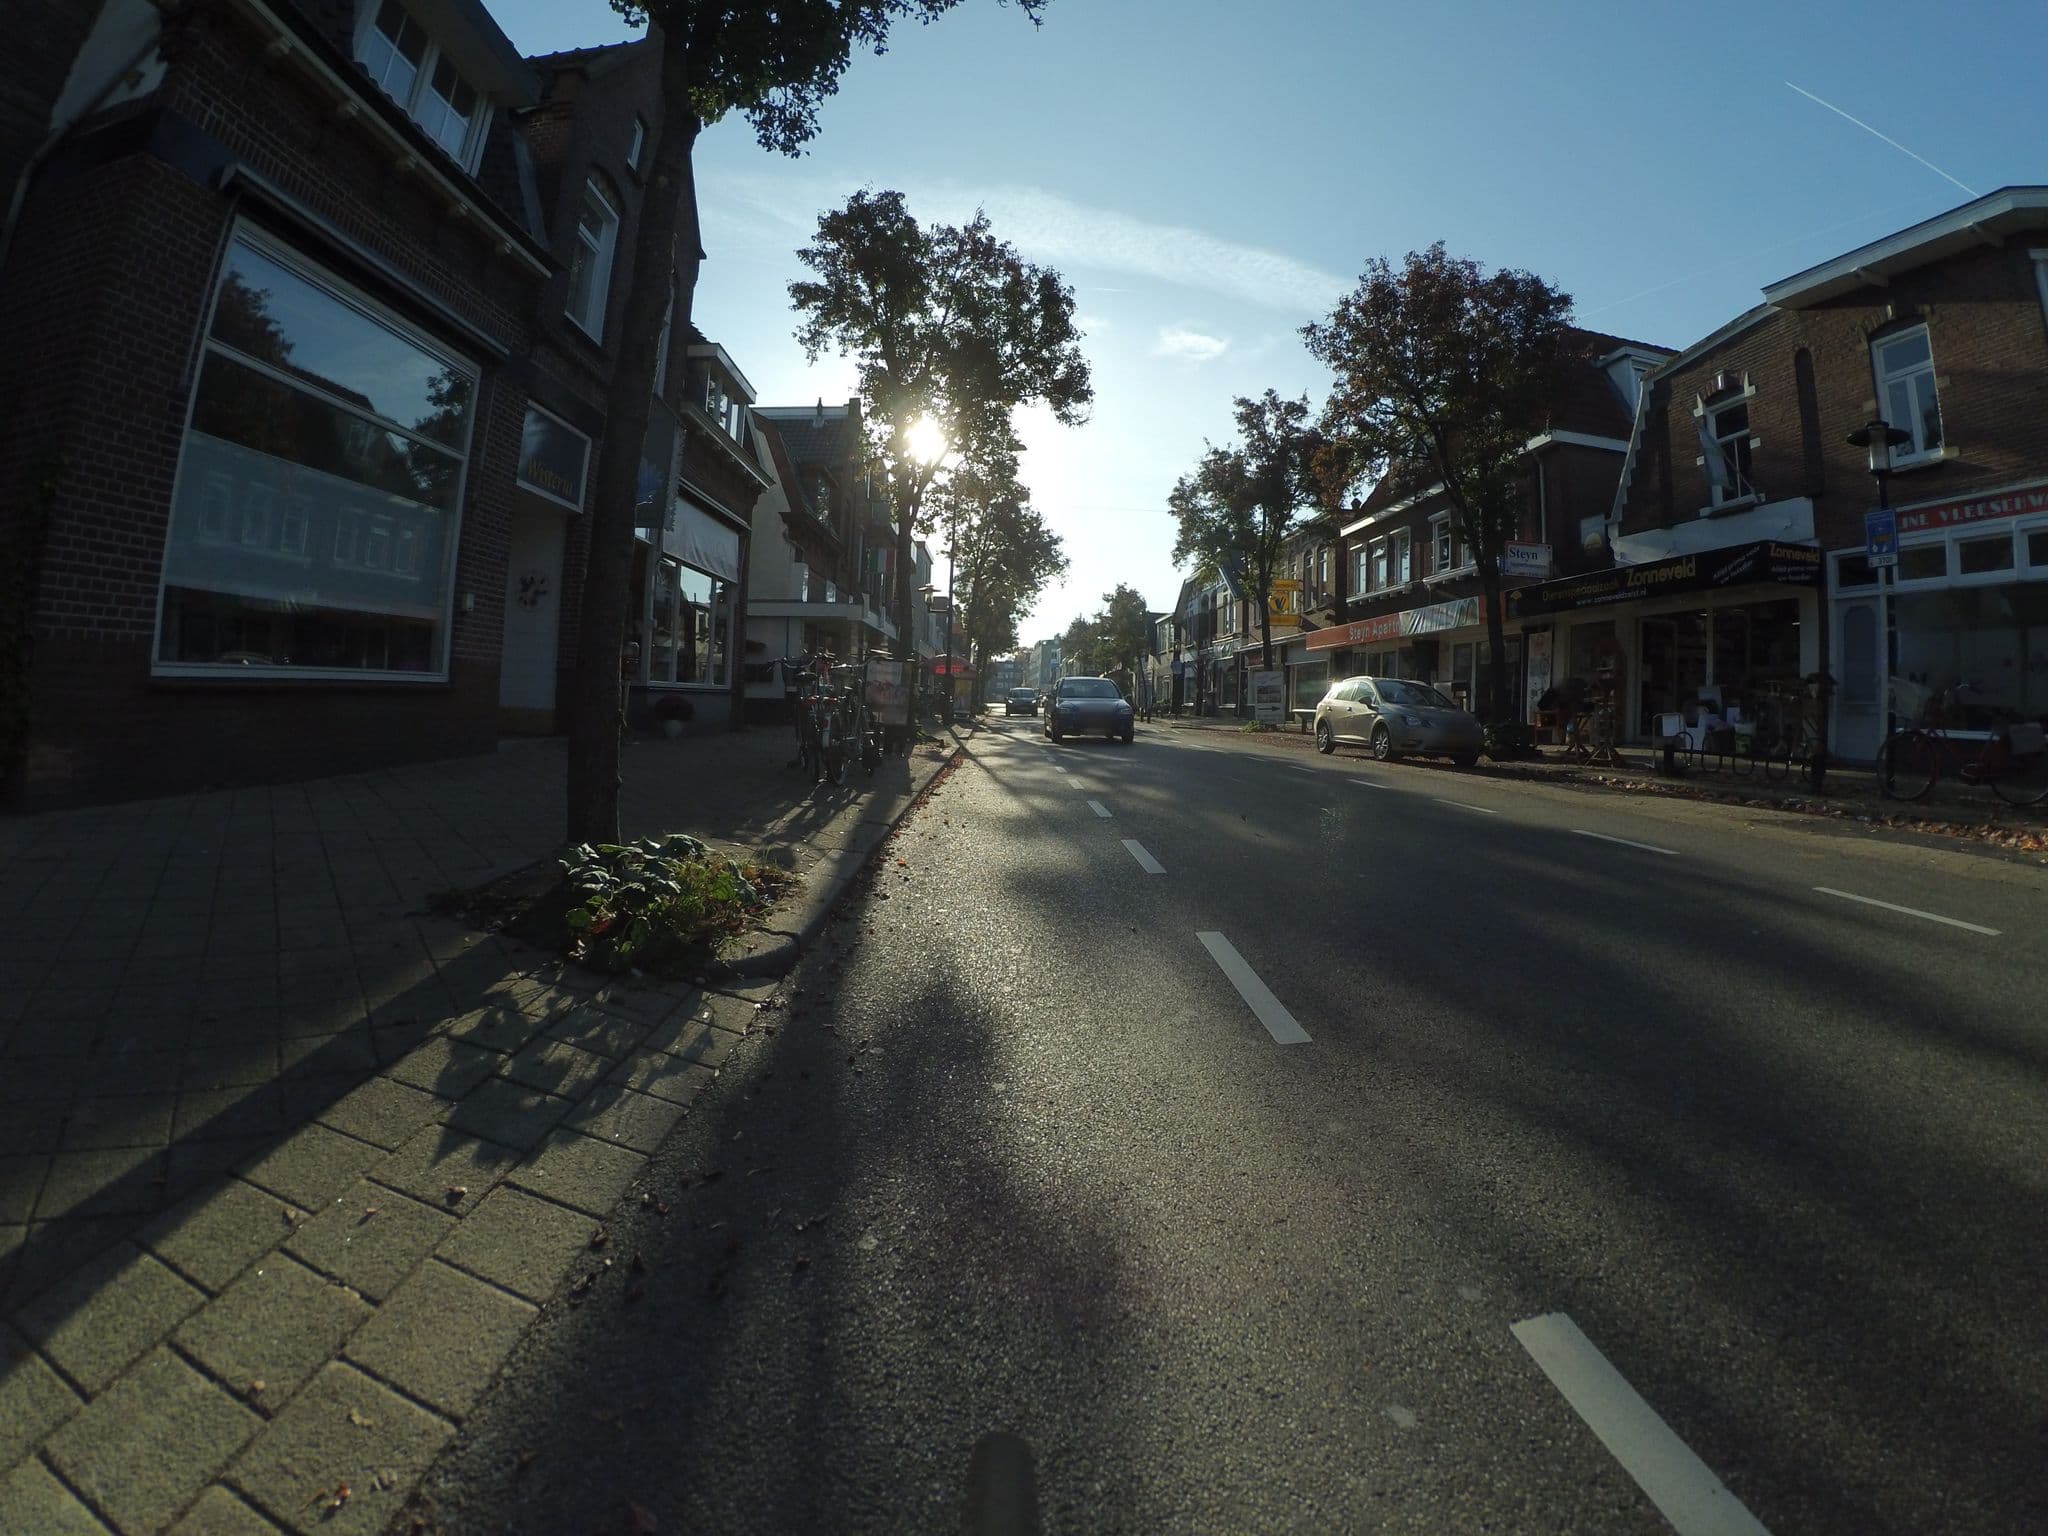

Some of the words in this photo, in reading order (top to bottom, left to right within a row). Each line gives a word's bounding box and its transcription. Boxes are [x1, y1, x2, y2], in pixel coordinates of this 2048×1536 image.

[1509, 546, 1538, 562] Steyn
[1767, 541, 1821, 564] Zonneveld
[1625, 556, 1697, 587] Zonneveld
[1349, 623, 1371, 642] Steyn
